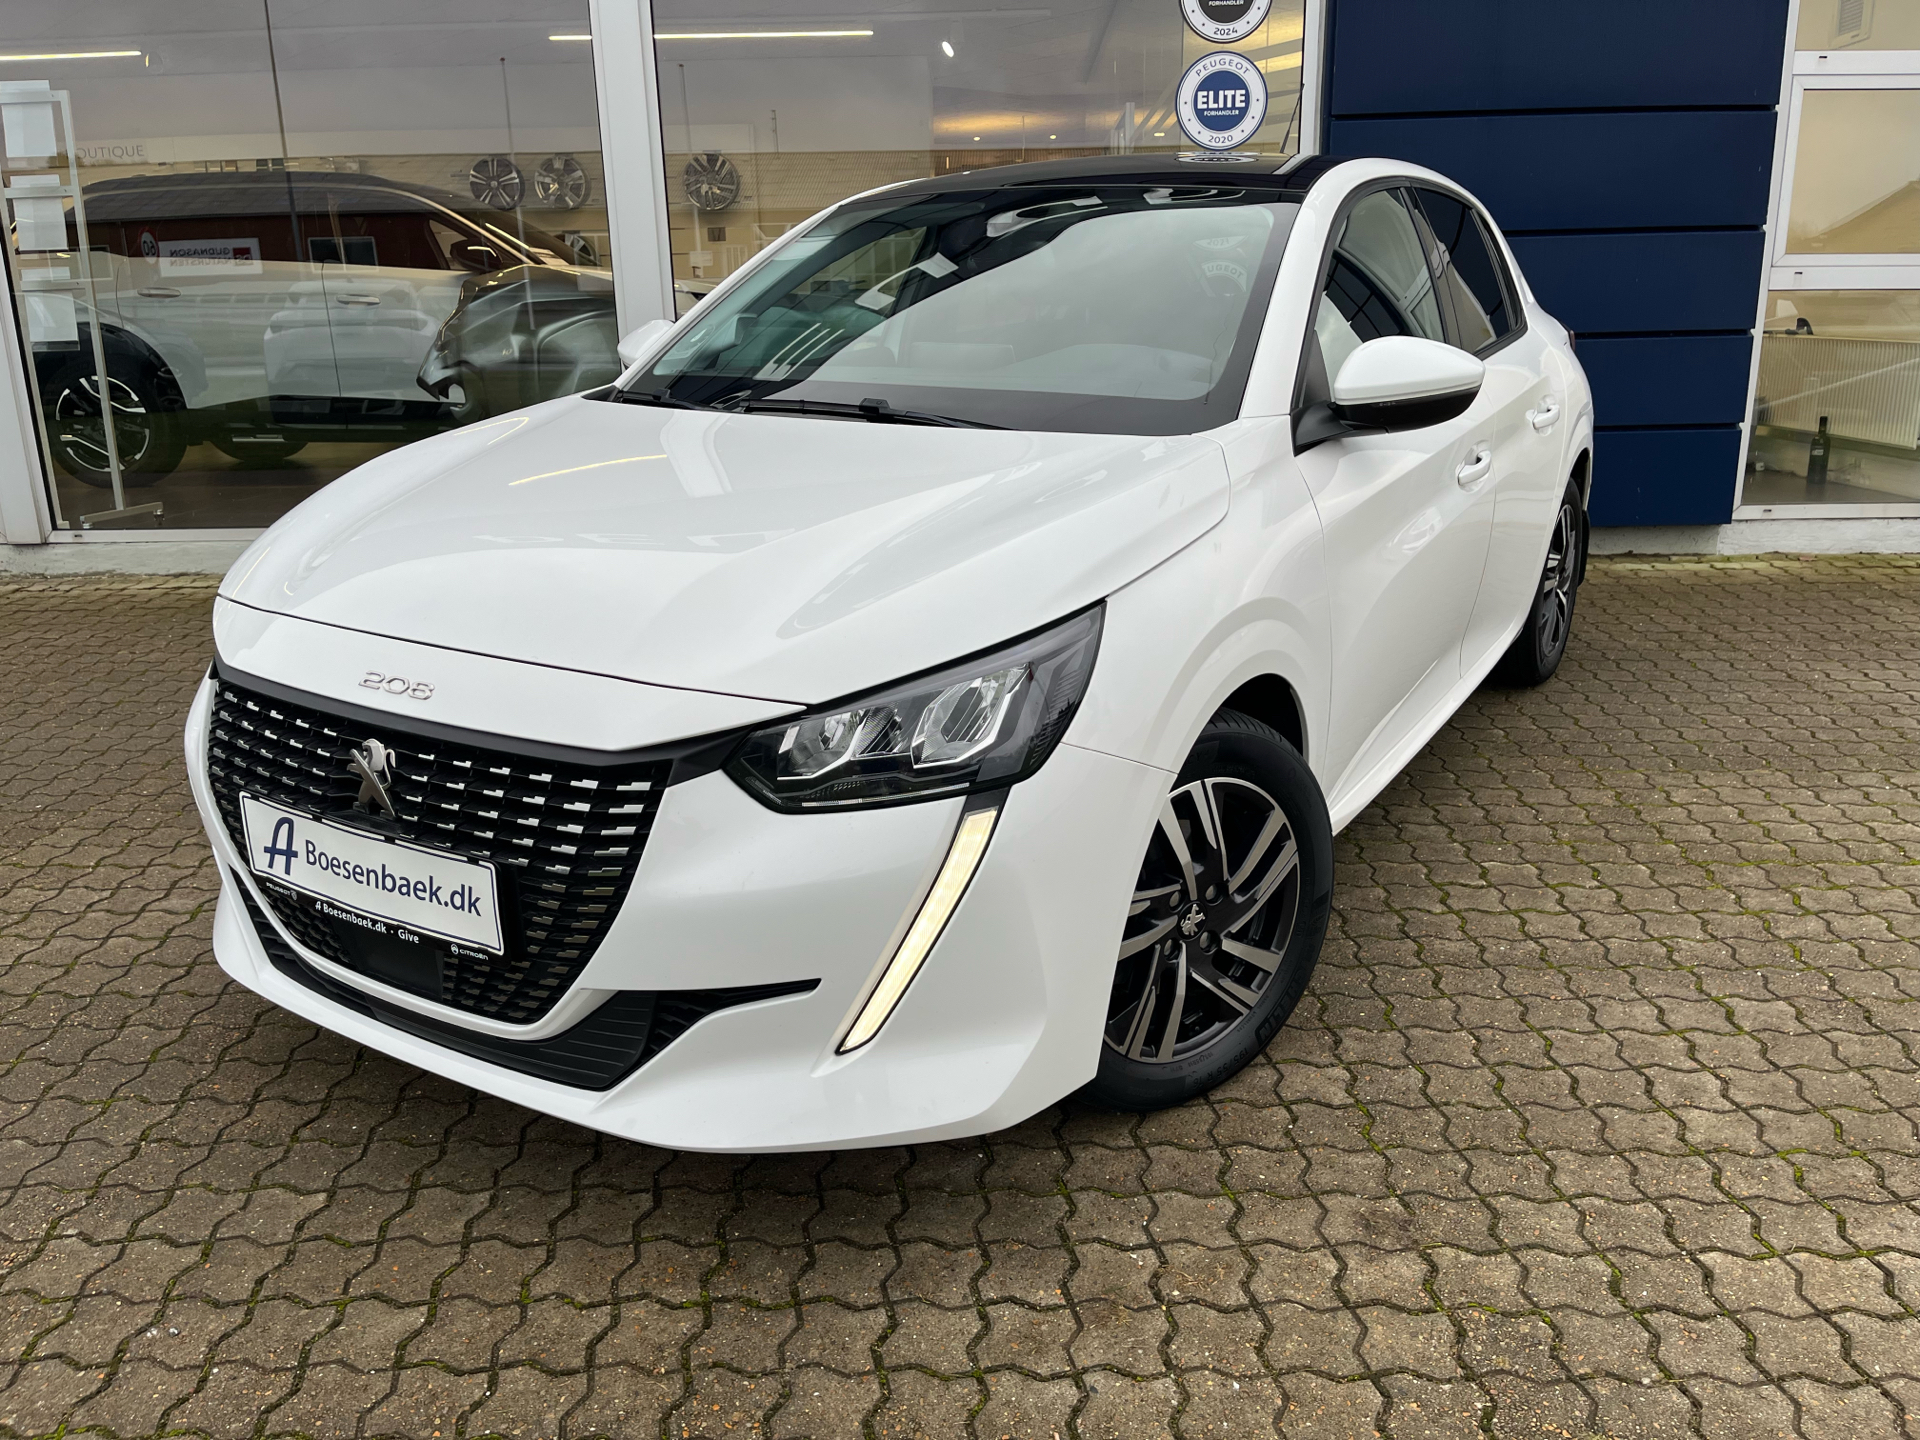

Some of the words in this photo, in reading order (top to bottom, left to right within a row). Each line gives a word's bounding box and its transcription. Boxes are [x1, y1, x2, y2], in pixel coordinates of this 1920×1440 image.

[1213, 26, 1238, 36] 2024
[1195, 58, 1251, 77] PEUGEOT
[1197, 89, 1246, 110] ELITE
[1208, 134, 1234, 144] 2020
[75, 145, 145, 159] OUTIQUE
[1206, 264, 1245, 279] UGEOT
[358, 670, 436, 701] 208
[263, 816, 299, 876] A
[305, 839, 482, 918] Boesenbaek.dk
[315, 901, 322, 911] A
[323, 903, 388, 934] Boesenbaek.dk
[398, 929, 420, 944] Give
